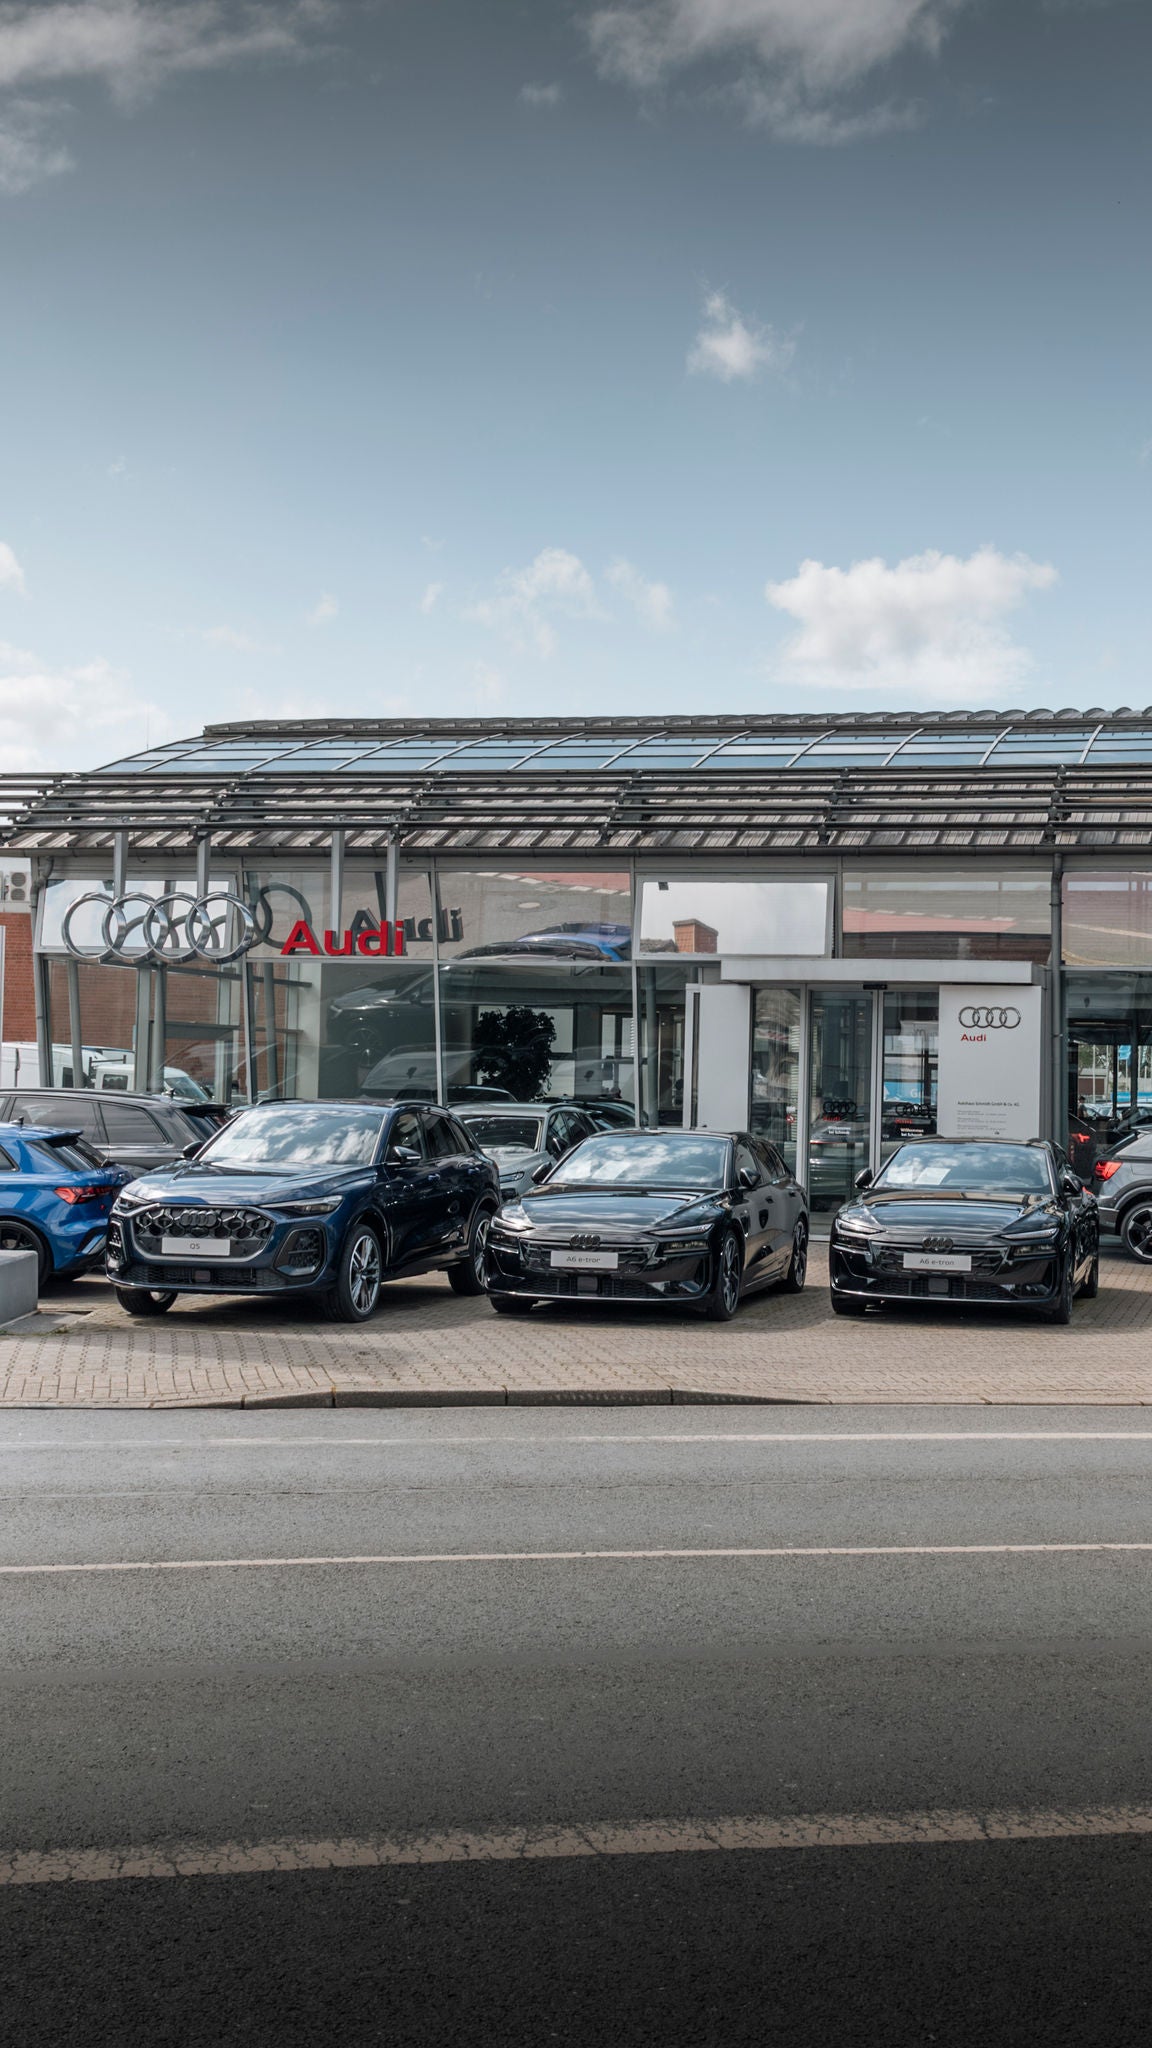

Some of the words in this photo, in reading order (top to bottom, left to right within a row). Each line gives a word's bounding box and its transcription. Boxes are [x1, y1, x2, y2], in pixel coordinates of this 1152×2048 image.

[280, 920, 405, 956] Audi
[960, 1033, 987, 1042] Audi
[566, 1255, 577, 1263] A6
